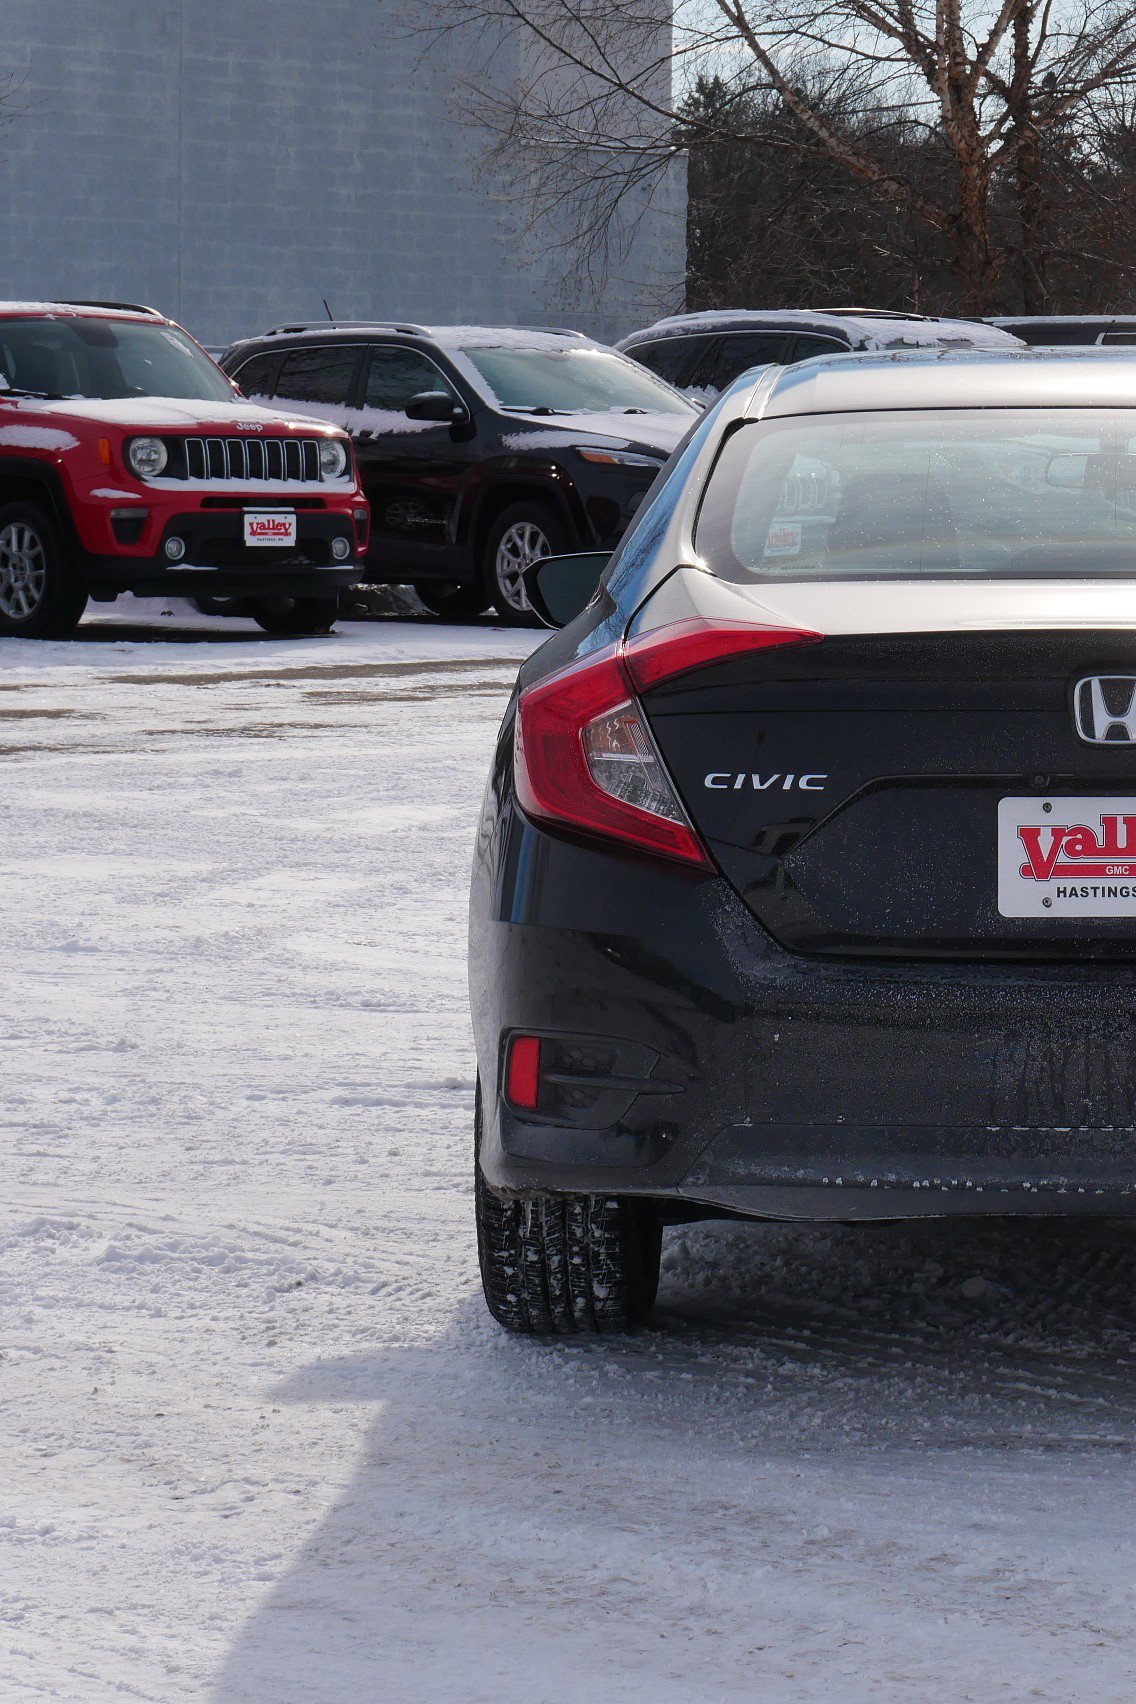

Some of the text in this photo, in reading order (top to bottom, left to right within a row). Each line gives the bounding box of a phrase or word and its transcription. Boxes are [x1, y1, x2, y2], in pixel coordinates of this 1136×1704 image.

[236, 422, 264, 432] Jeep
[248, 519, 292, 536] Valley
[704, 773, 828, 790] CIVIC
[1105, 866, 1130, 875] GMC
